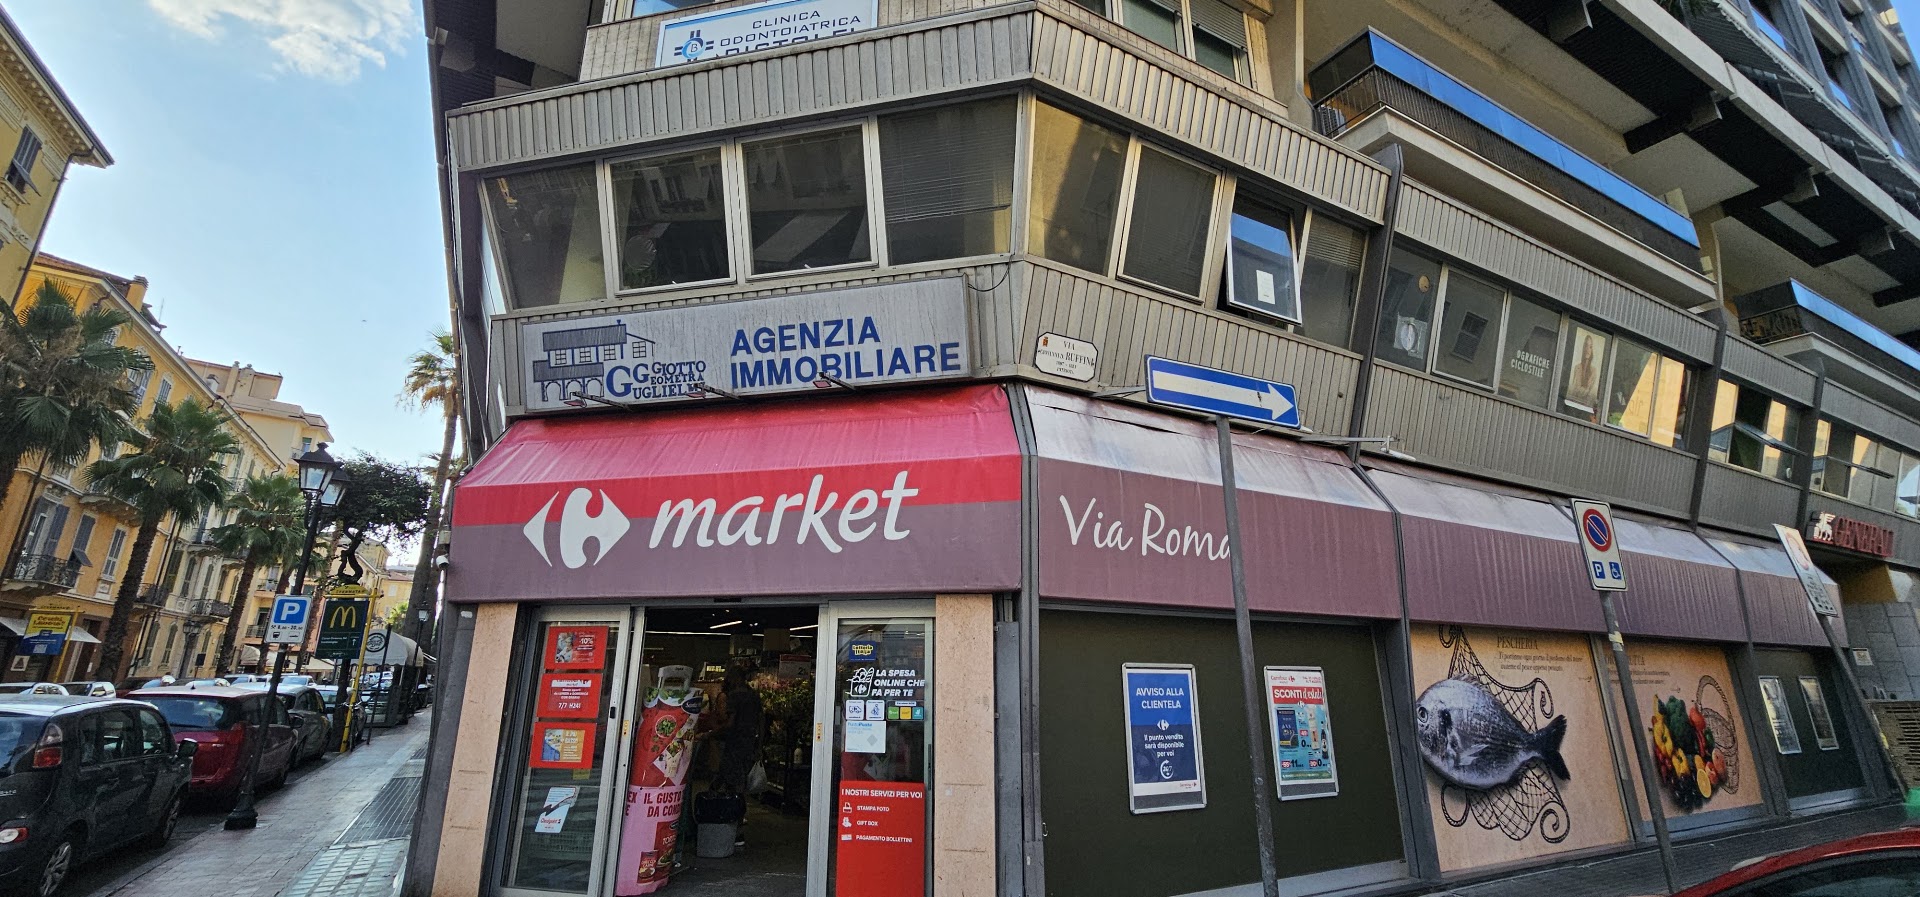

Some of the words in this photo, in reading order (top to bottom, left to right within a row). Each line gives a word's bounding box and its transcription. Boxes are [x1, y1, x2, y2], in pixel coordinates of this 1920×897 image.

[752, 10, 821, 29] CLINICA
[719, 15, 861, 47] ODONTOIATRICA
[731, 316, 881, 357] AGENZIA
[1063, 340, 1075, 351] VIA
[652, 361, 706, 376] GIOTTO
[731, 342, 961, 389] IMMOBILIARE
[1511, 358, 1545, 378] CICLOSTILE
[649, 470, 919, 554] market
[1059, 495, 1134, 551] Via
[1595, 563, 1603, 577] P
[280, 602, 300, 620] P
[872, 689, 883, 697] FA
[884, 689, 901, 697] PER
[903, 689, 914, 697] TE
[1136, 687, 1165, 697] AVVISO
[1166, 688, 1185, 697] ALLA
[1274, 689, 1302, 699] SCONTI
[558, 702, 568, 710] 7/7
[1141, 700, 1182, 709] CLIENTELA
[1149, 734, 1165, 742] punto
[1144, 742, 1157, 750] sarà
[1157, 741, 1185, 750] disponibile
[643, 793, 653, 804] IL
[870, 789, 895, 798] SERVIZI
[896, 791, 909, 799] PER
[647, 806, 660, 817] DA
[856, 834, 885, 842] PAGAMENTO
